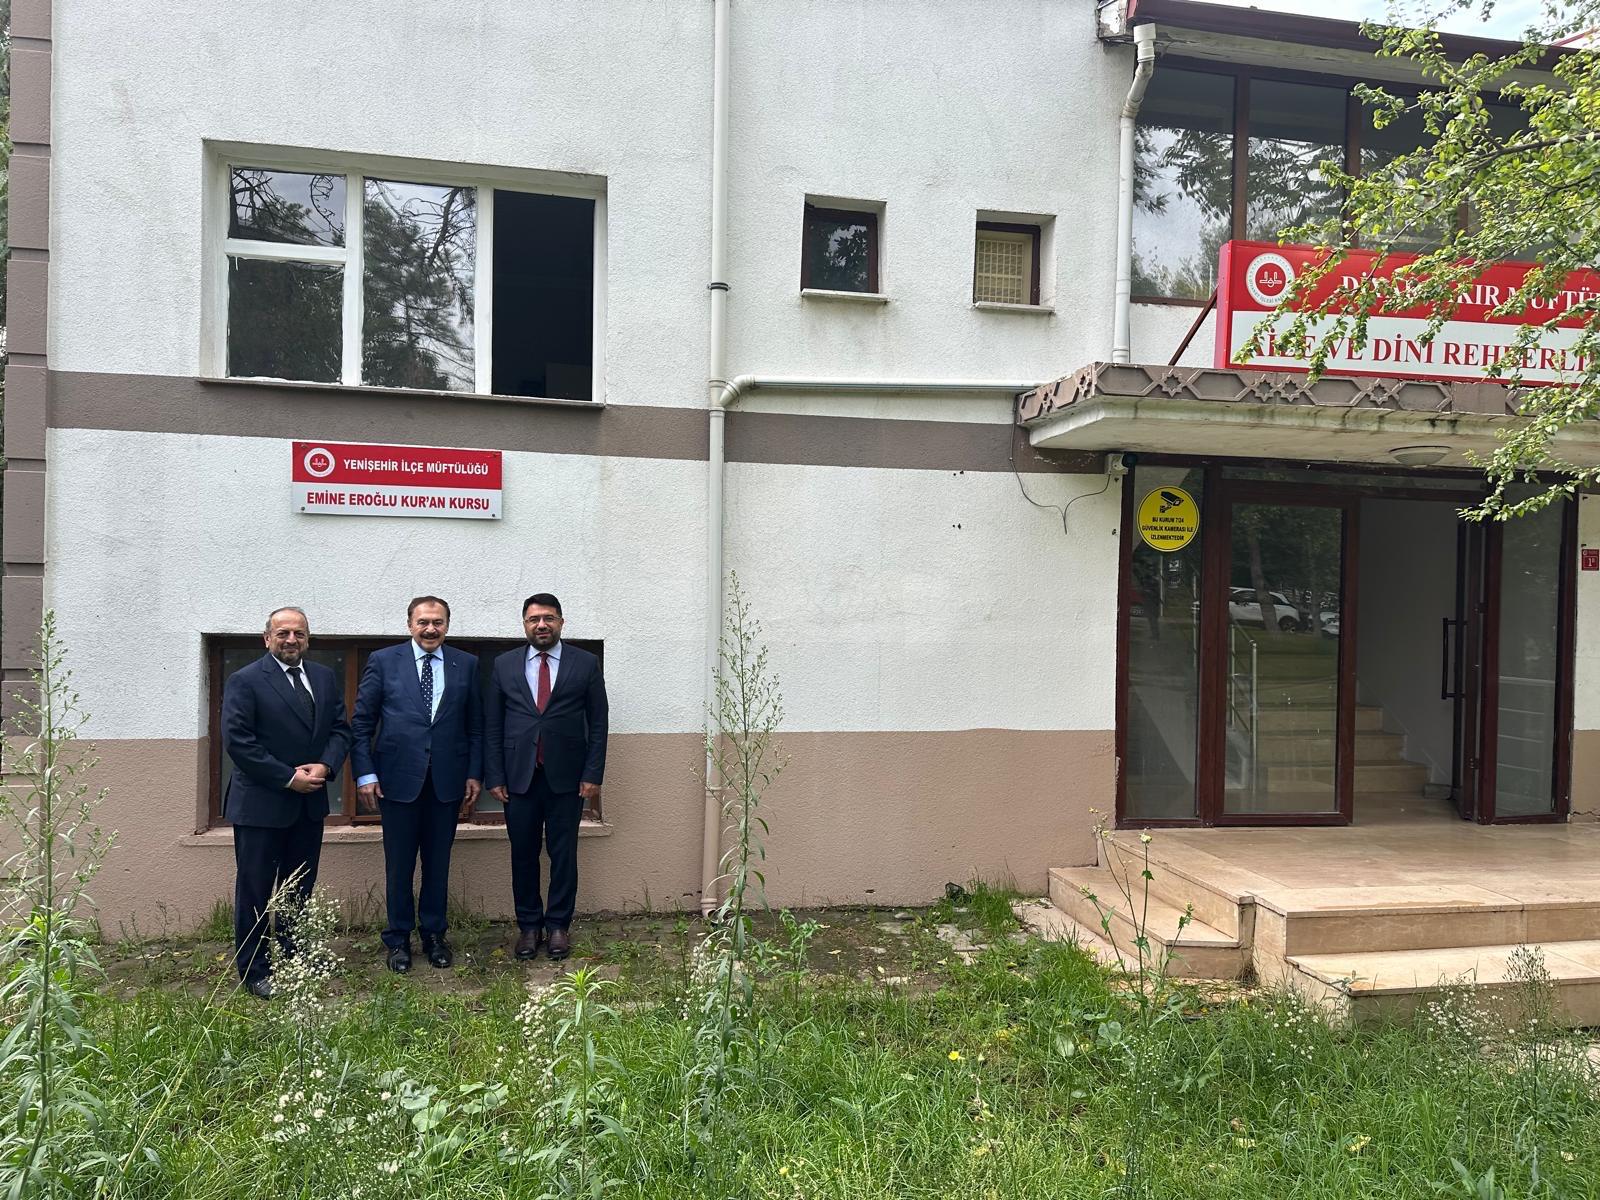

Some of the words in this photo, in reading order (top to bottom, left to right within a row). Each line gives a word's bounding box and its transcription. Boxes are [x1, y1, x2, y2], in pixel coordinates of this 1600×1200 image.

[1371, 333, 1435, 365] DİNİ
[343, 459, 399, 473] YENİŞEHİR
[401, 459, 424, 475] İLÇE
[426, 460, 489, 475] MÜFTÜLÜĞÜ
[307, 490, 346, 506] EMİNE
[349, 491, 397, 507] EROĞLU
[401, 495, 446, 509] KUR'AN
[450, 497, 490, 510] KURSU
